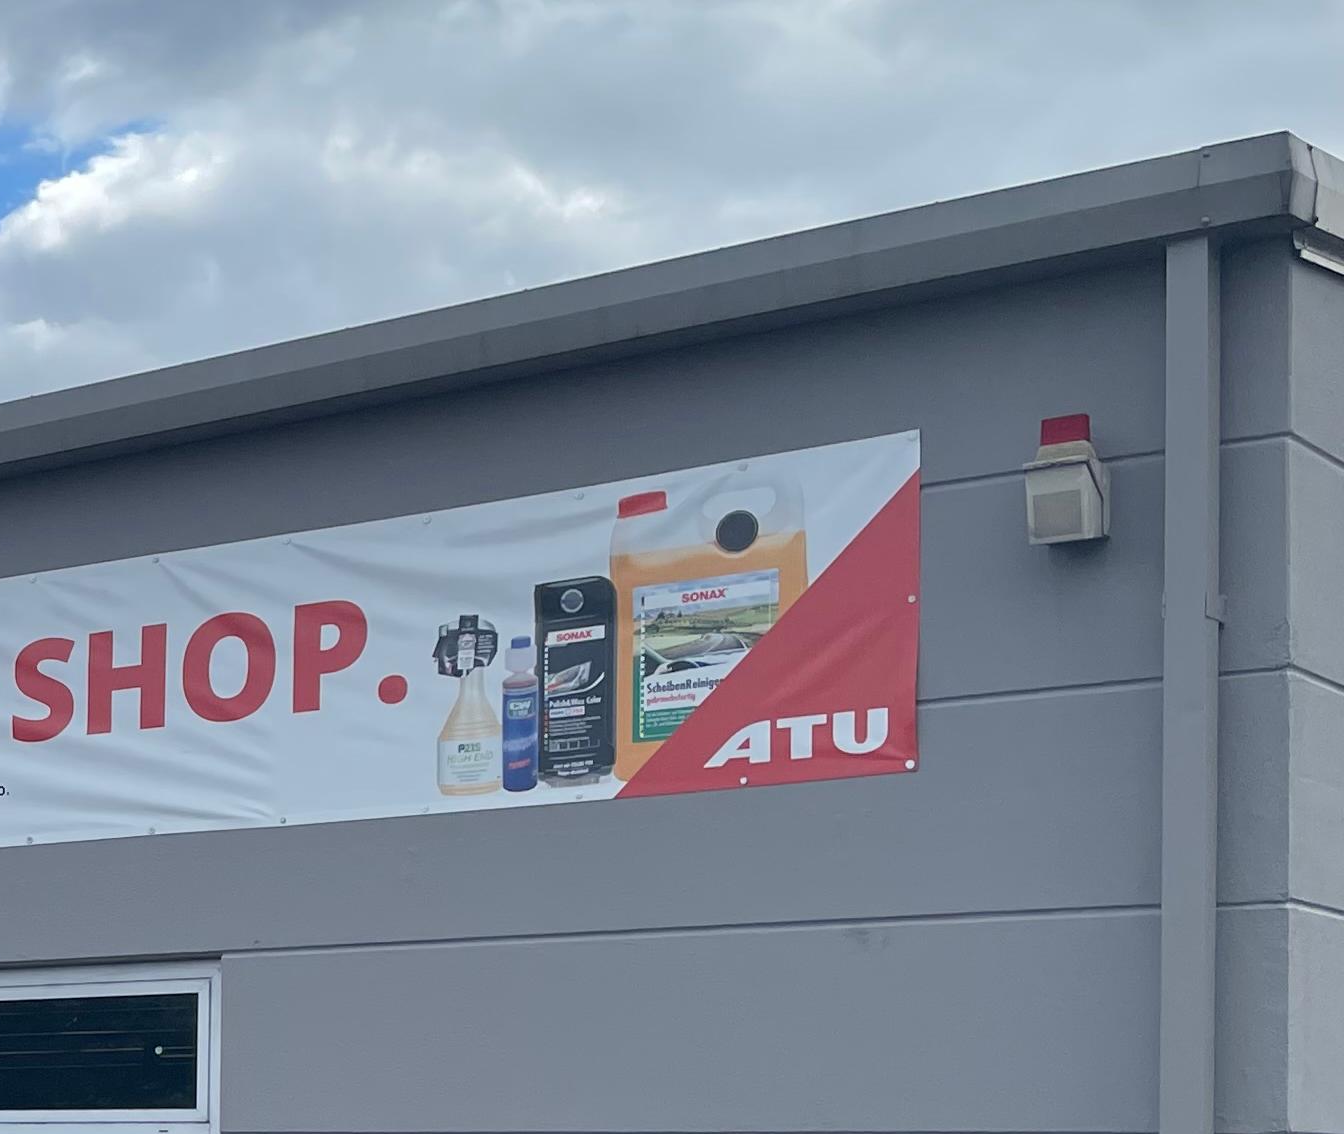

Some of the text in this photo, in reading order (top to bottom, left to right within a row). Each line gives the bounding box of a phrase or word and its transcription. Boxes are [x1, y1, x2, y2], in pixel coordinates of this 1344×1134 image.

[682, 588, 725, 603] SONAX
[556, 630, 592, 642] SONAX
[12, 600, 408, 742] SHOP.
[704, 708, 888, 768] ATU
